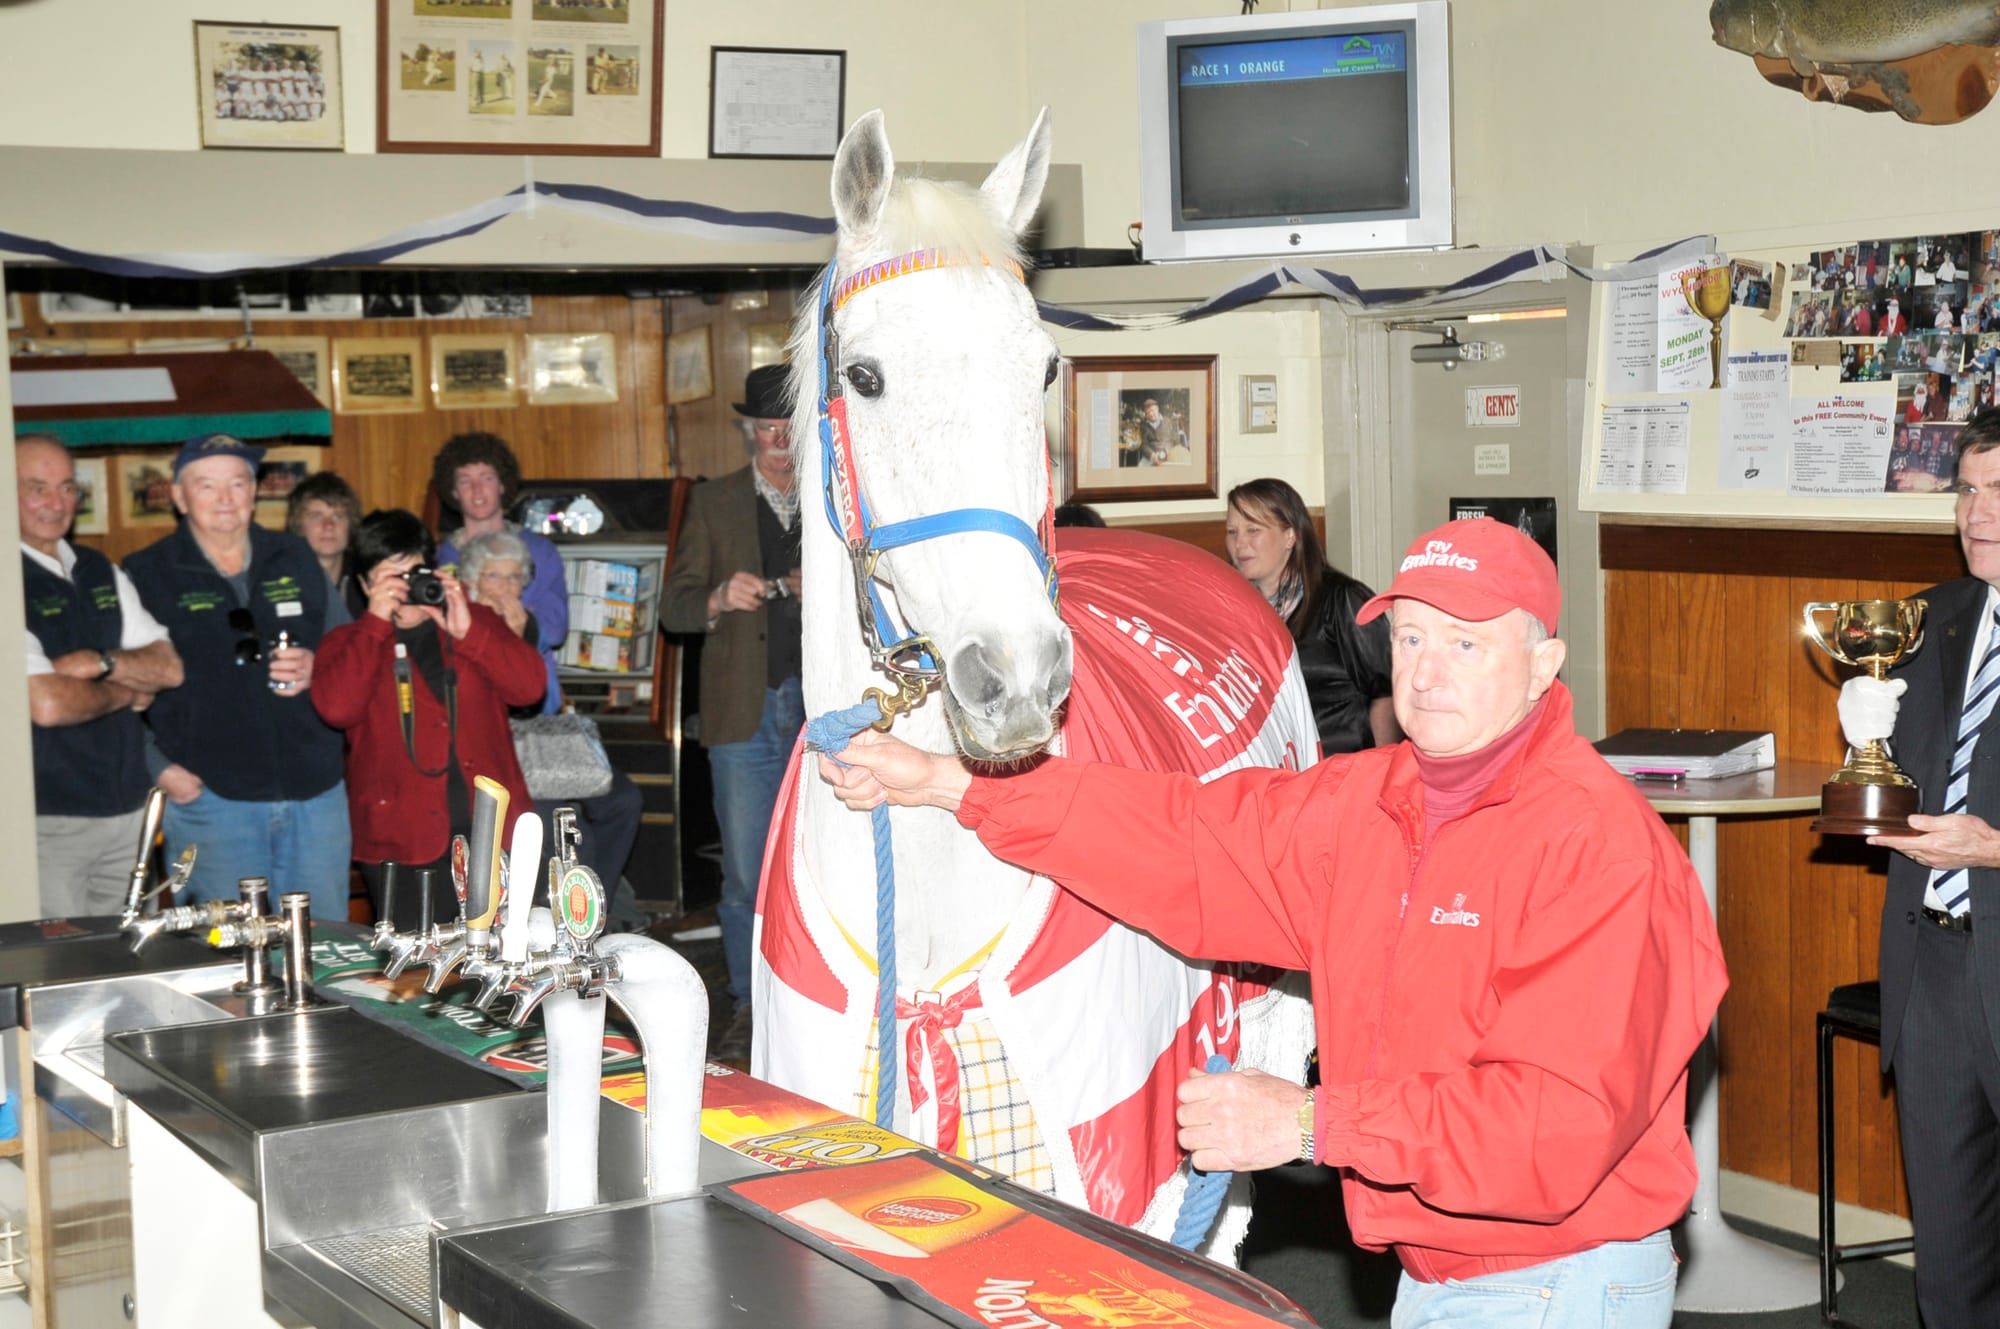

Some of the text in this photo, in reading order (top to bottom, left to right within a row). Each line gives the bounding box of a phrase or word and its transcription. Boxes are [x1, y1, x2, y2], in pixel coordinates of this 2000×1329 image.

[1191, 60, 1286, 77] RACE 1 ORANGE
[1670, 264, 1708, 281] COMING
[1667, 328, 1704, 350] MONDAY
[1660, 352, 1685, 368] SEPT.
[1688, 346, 1705, 360] 28th
[1485, 394, 1516, 417] GENTS
[1832, 400, 1865, 408] WELCOME
[1815, 412, 1832, 420] FREE
[1833, 412, 1868, 421] Community
[1869, 413, 1887, 424] Event
[1425, 540, 1453, 554] Fly
[1399, 552, 1478, 573] Emirates
[564, 874, 593, 900] CARLTON
[1429, 906, 1480, 927] Emirates
[568, 918, 591, 934] LIGHT
[877, 1207, 945, 1223] CARLTON
[884, 1203, 961, 1219] DRAUGHT
[973, 1277, 1062, 1329] LTON
